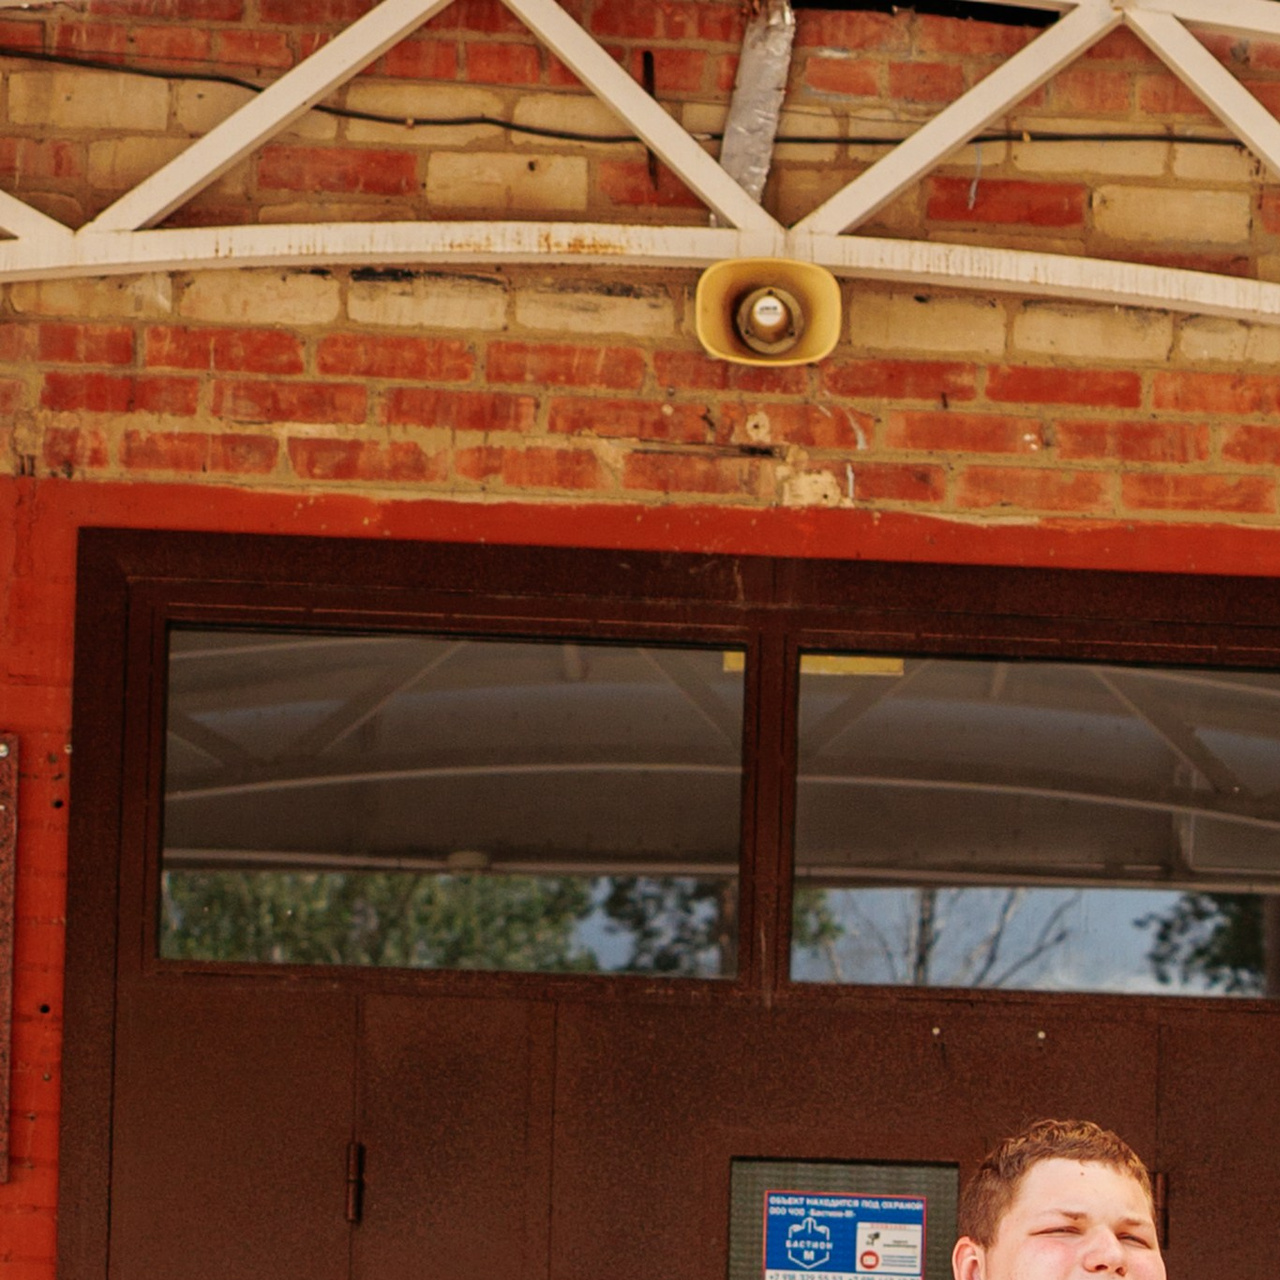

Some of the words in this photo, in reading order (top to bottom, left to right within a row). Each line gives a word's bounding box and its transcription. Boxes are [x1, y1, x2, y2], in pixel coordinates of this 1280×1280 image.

[769, 1196, 804, 1206] ОБЪЕКТ
[806, 1198, 860, 1208] НАХОДИТСЯ
[861, 1200, 880, 1210] ПОД
[882, 1200, 923, 1211] ОХРАНОЙ
[786, 1240, 833, 1250] БАСТИОН
[803, 1250, 815, 1261] М
